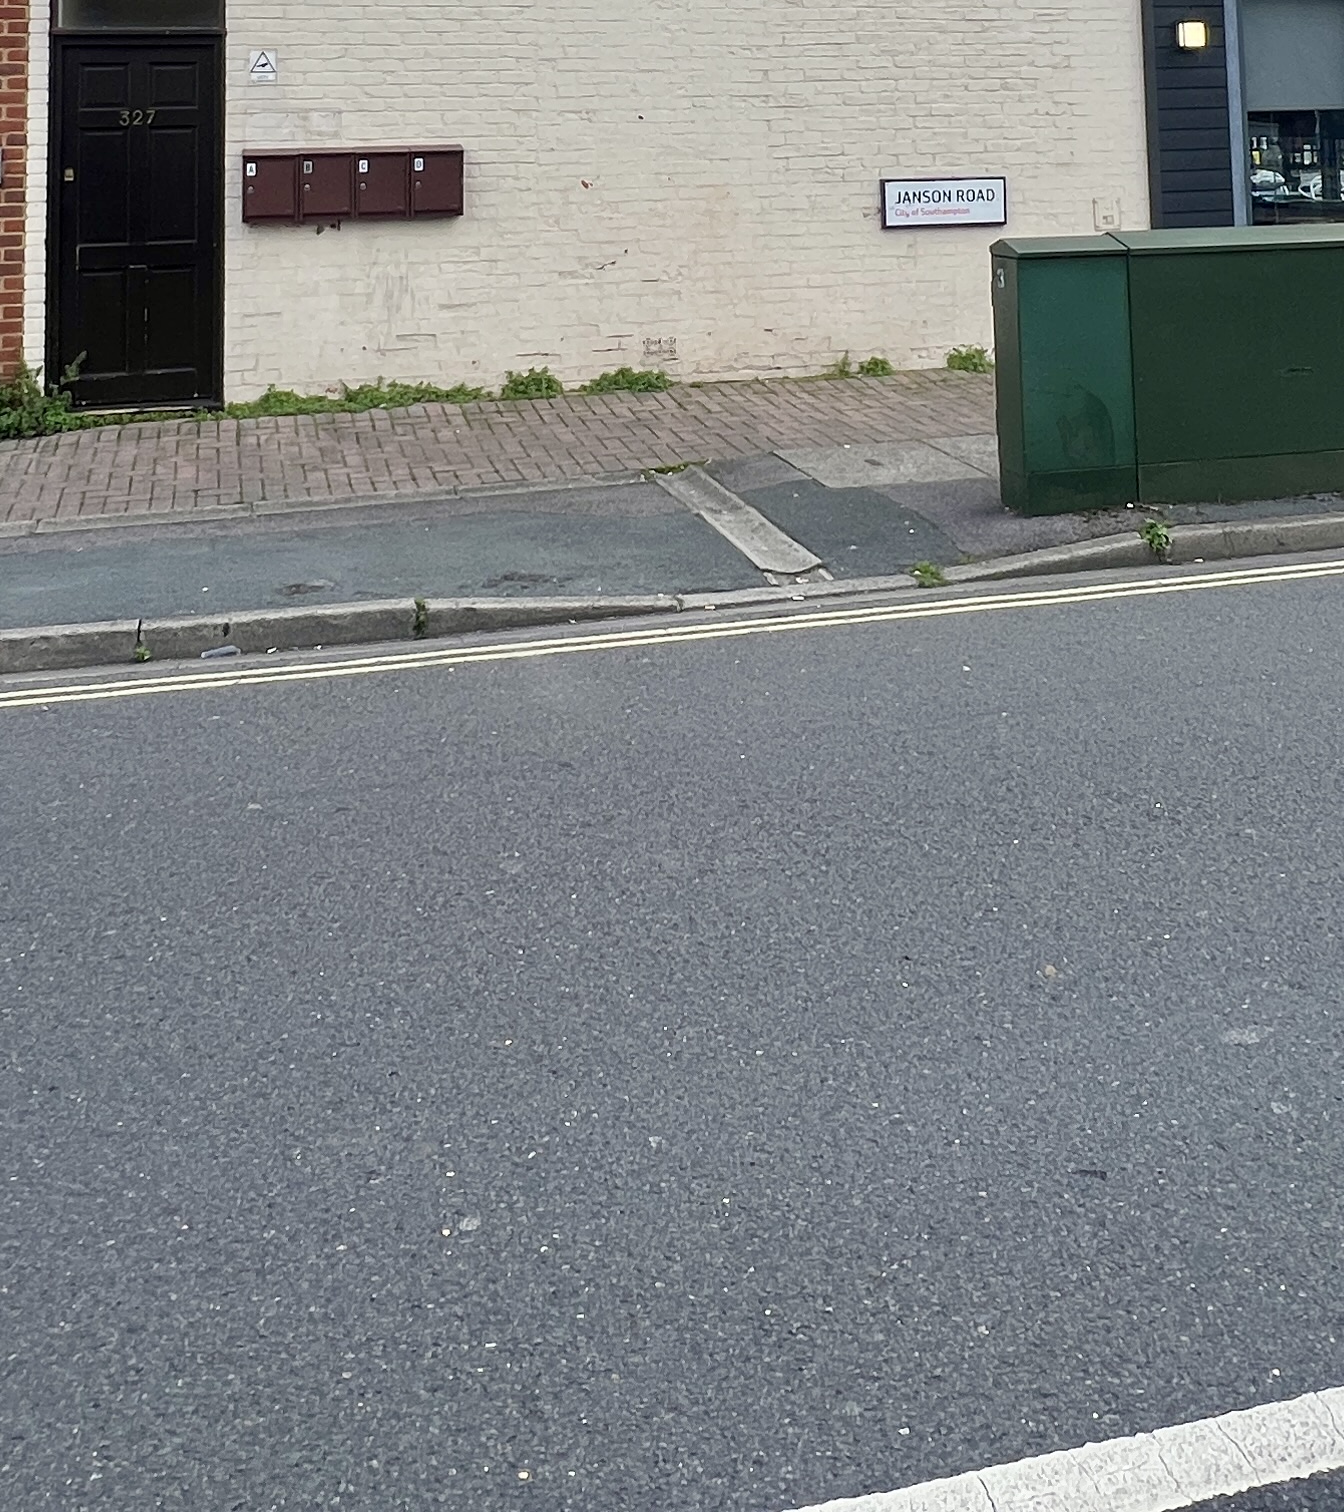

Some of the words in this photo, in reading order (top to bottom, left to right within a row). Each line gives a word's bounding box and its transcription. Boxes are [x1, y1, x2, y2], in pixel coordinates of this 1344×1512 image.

[119, 109, 156, 126] 327
[247, 165, 255, 174] A
[305, 163, 311, 172] B
[360, 161, 366, 170] C
[895, 189, 952, 205] JANSON
[956, 188, 996, 203] ROAD
[894, 207, 910, 218] City
[911, 207, 919, 216] of
[921, 207, 970, 218] Southampton
